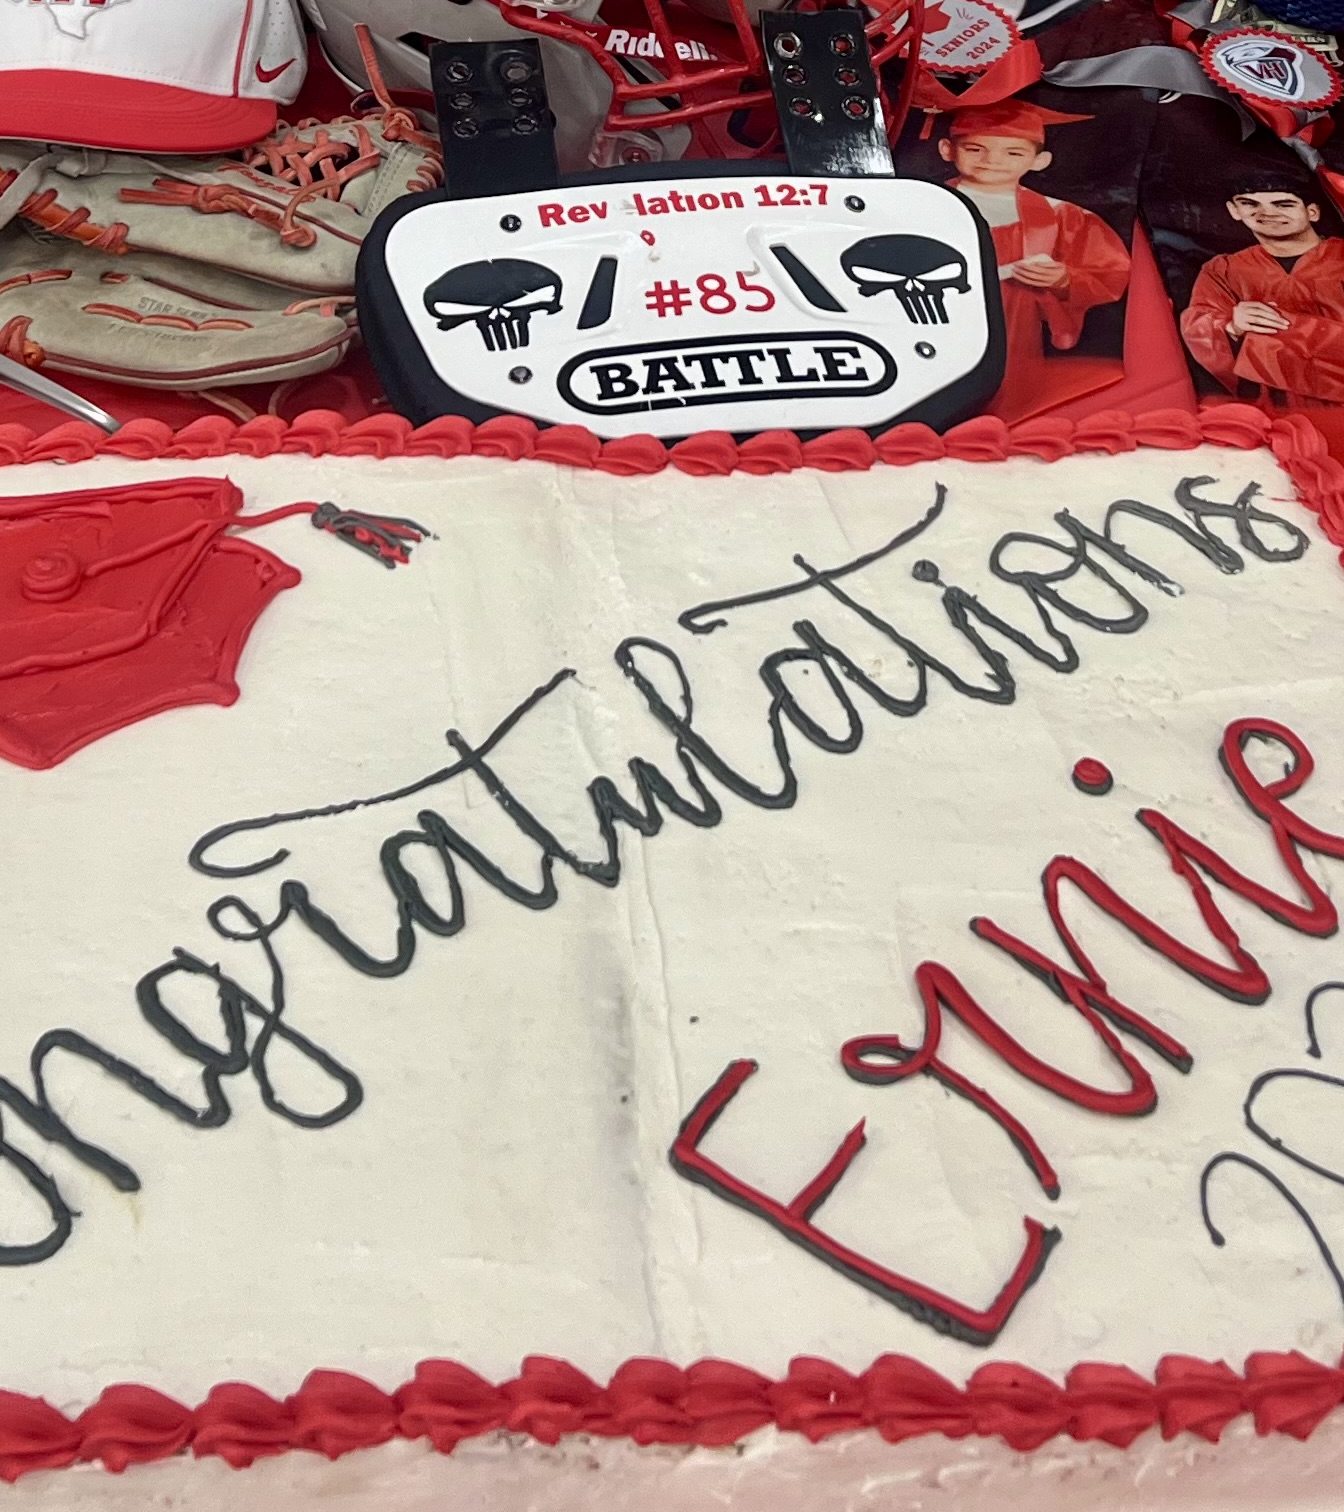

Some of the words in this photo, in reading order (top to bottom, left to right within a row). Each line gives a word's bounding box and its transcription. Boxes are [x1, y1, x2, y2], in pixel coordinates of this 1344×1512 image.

[935, 18, 991, 58] SENIORS
[966, 36, 1002, 60] 2024
[1242, 61, 1287, 80] VH
[754, 183, 829, 207] 12:7
[590, 345, 869, 402] BATTLE
